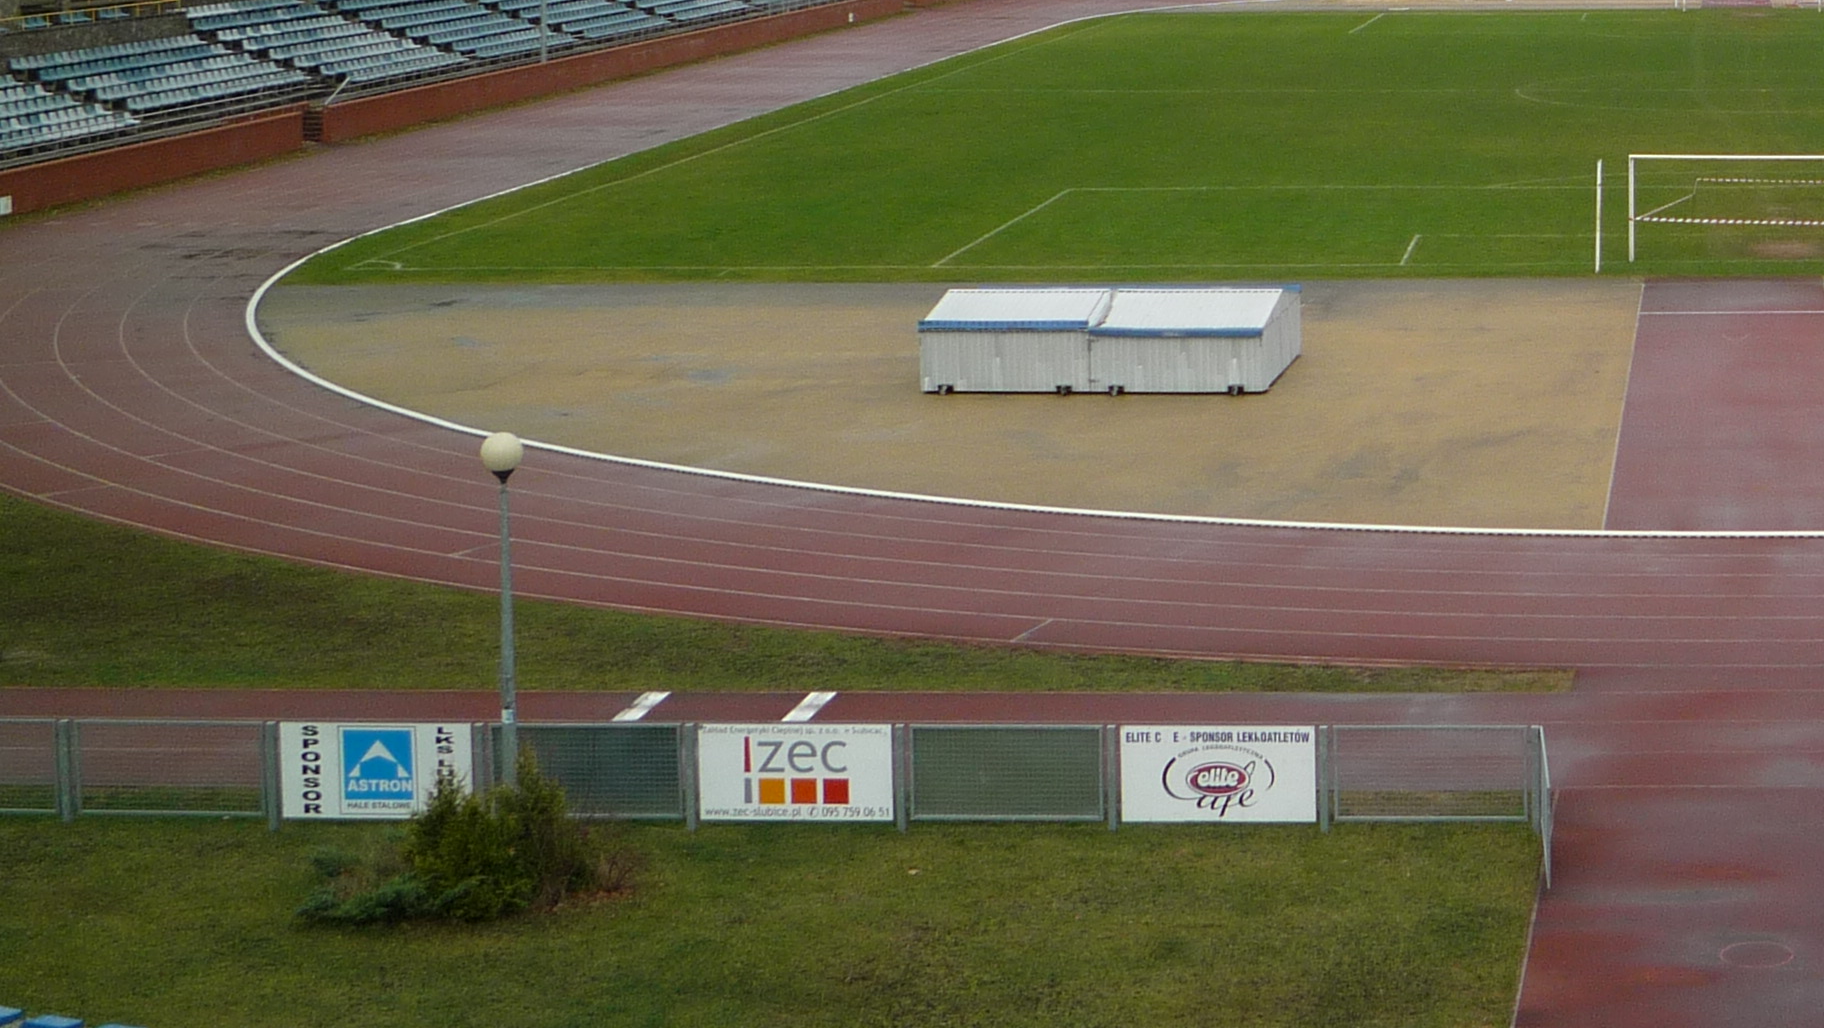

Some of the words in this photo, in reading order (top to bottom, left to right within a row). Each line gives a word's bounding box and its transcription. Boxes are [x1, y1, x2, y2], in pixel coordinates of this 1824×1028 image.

[1126, 732, 1151, 742] ELITE
[1190, 732, 1233, 742] SPONSOR
[757, 740, 848, 773] zec
[300, 726, 322, 814] SPONSOR
[347, 779, 412, 792] ASTRON
[822, 807, 838, 817] 095
[843, 807, 860, 817] 759
[879, 807, 890, 817] 51
